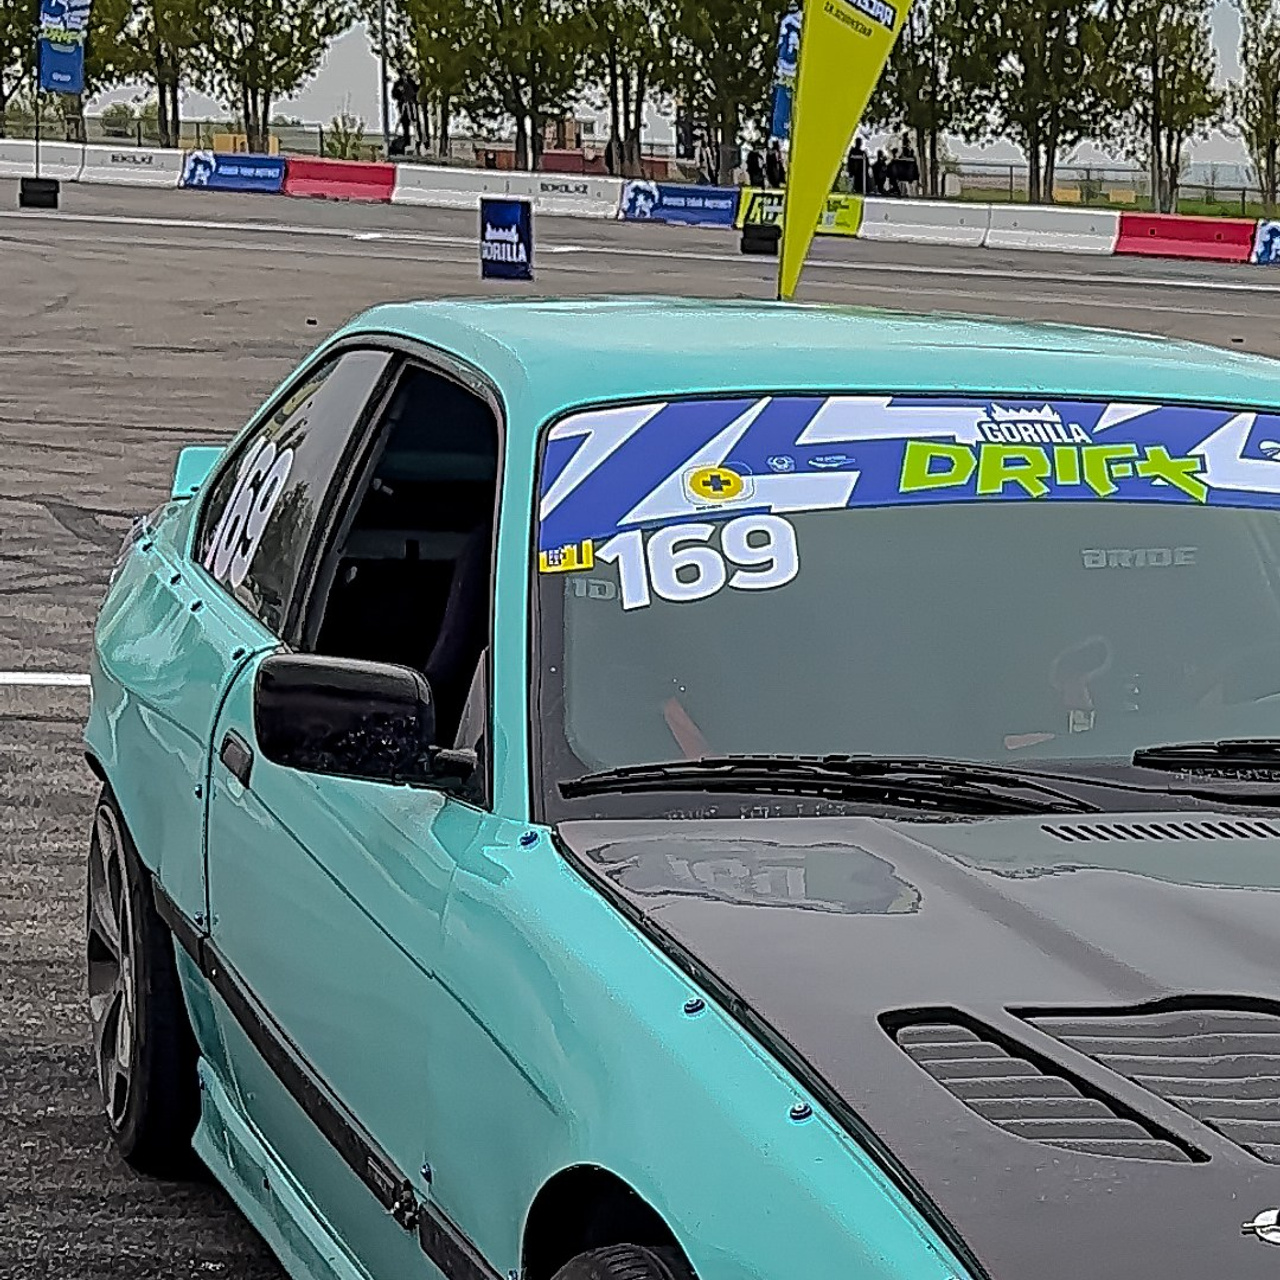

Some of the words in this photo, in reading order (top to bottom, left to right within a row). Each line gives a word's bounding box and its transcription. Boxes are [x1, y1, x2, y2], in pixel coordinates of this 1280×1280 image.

[981, 420, 1092, 446] GORILLA
[899, 439, 1208, 503] DRIFT
[203, 435, 294, 588] 169
[594, 513, 800, 611] 169
[1081, 546, 1198, 570] BRIDE
